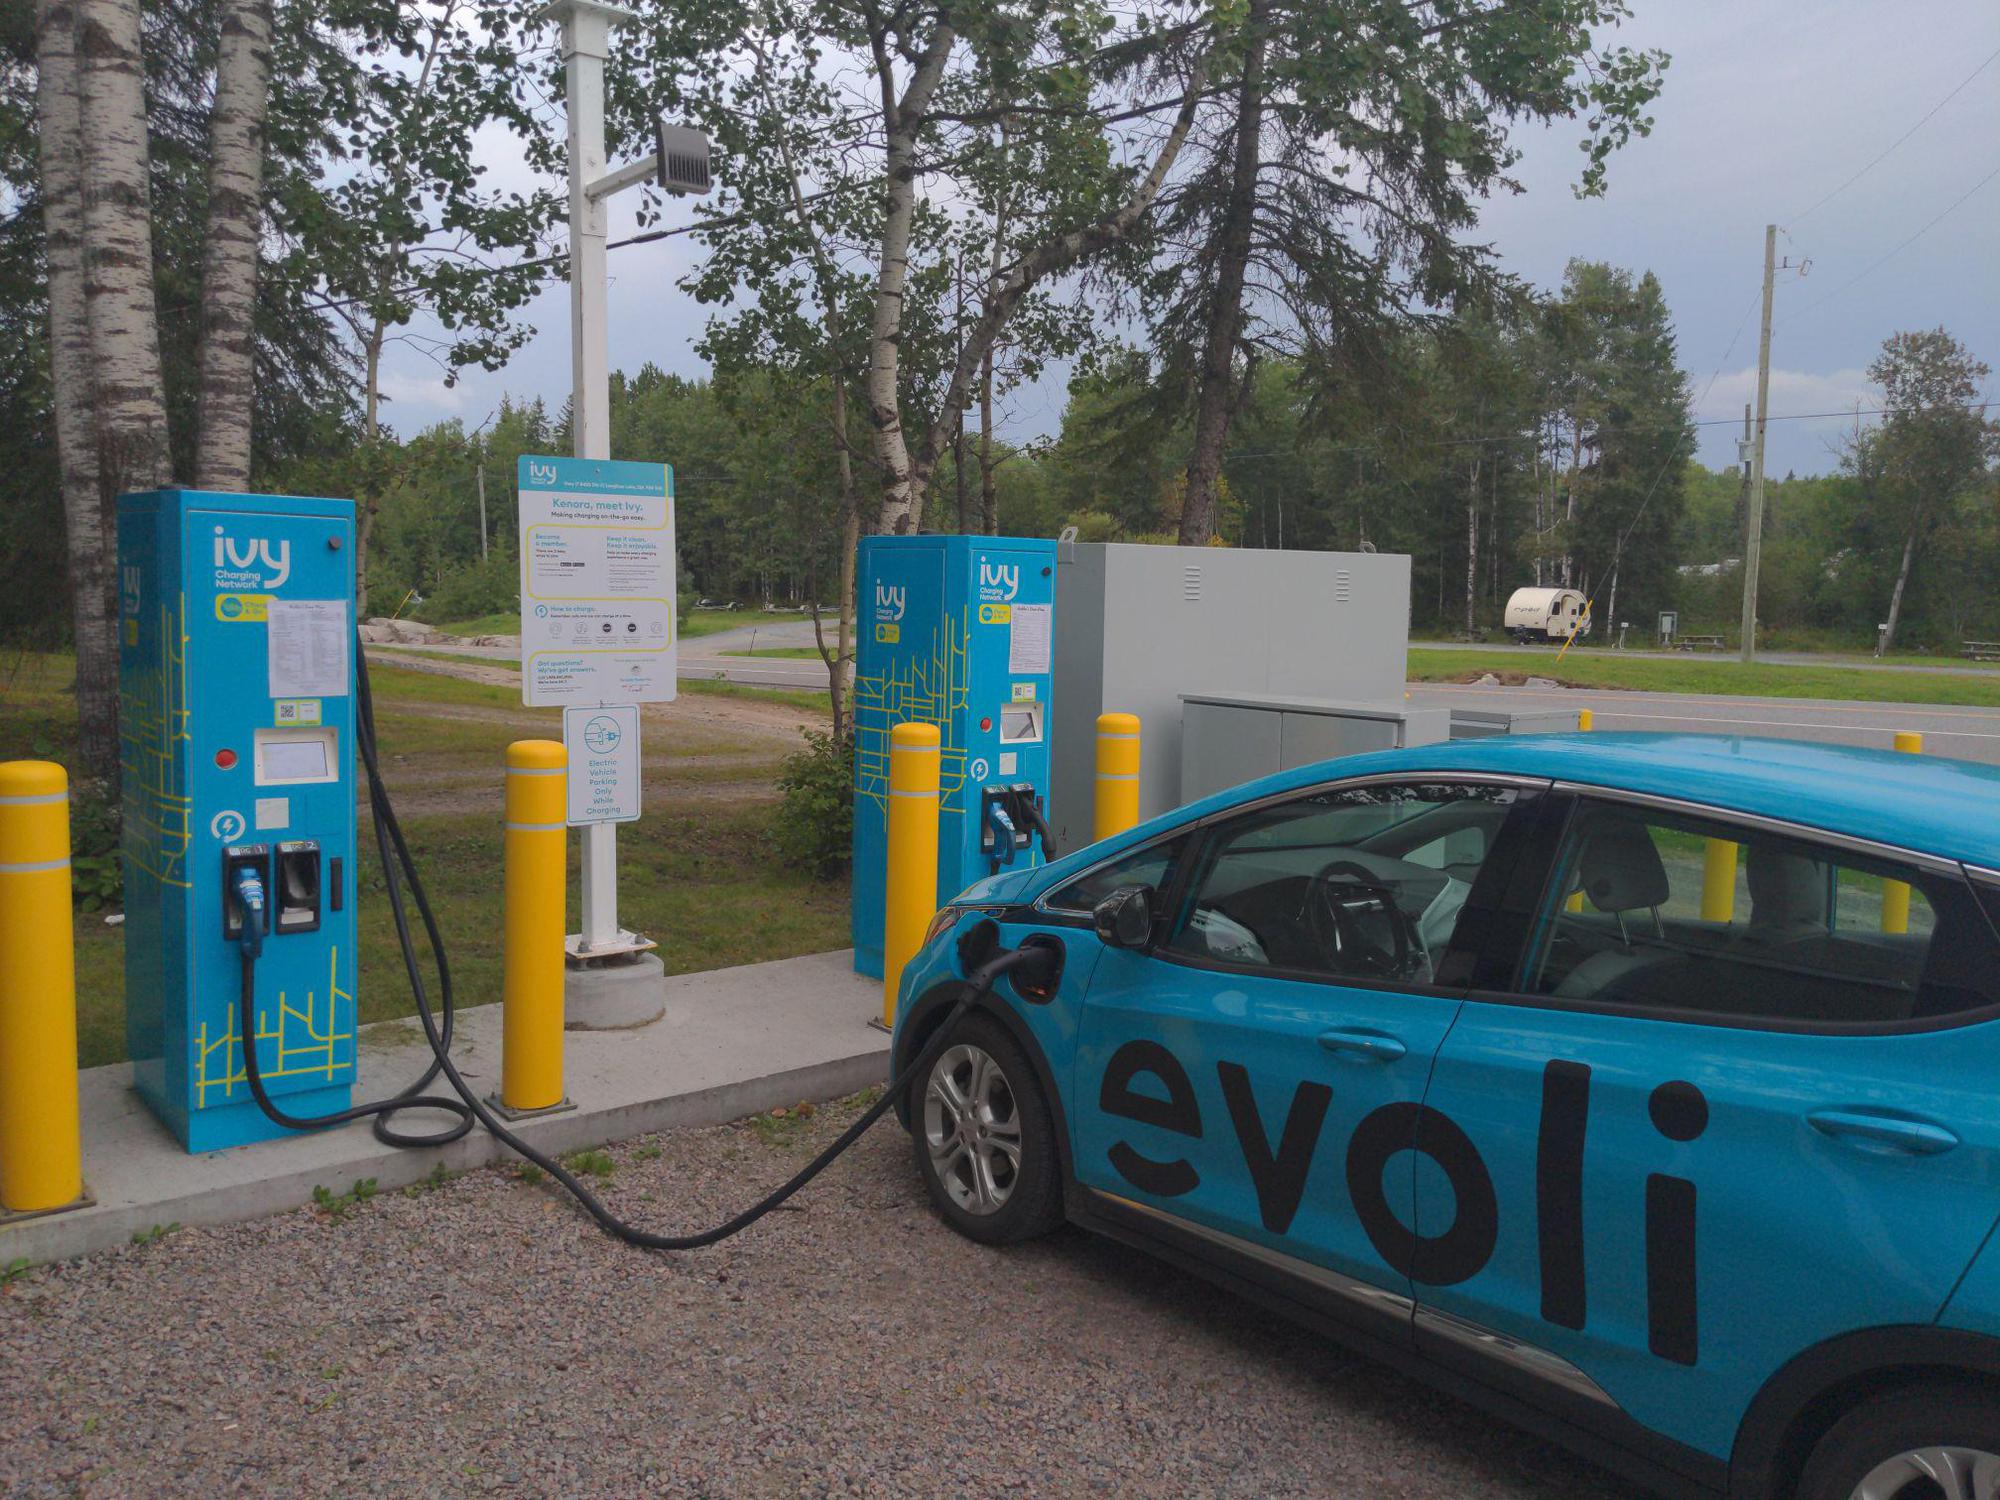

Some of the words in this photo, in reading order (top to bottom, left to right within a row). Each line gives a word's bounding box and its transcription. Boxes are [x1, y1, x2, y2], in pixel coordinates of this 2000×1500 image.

[530, 461, 557, 485] ivy
[552, 498, 594, 511] Kenora,
[595, 500, 623, 510] meet
[625, 500, 644, 513] Ivy.
[573, 513, 600, 521] charging
[214, 526, 290, 589] ivy
[215, 569, 261, 582] Charging
[980, 555, 1019, 601] ivy
[215, 579, 258, 589] Network
[876, 578, 906, 621] ivy
[588, 759, 617, 767] Electric
[586, 806, 621, 815] Charging
[1101, 1039, 1698, 1367] evoli
